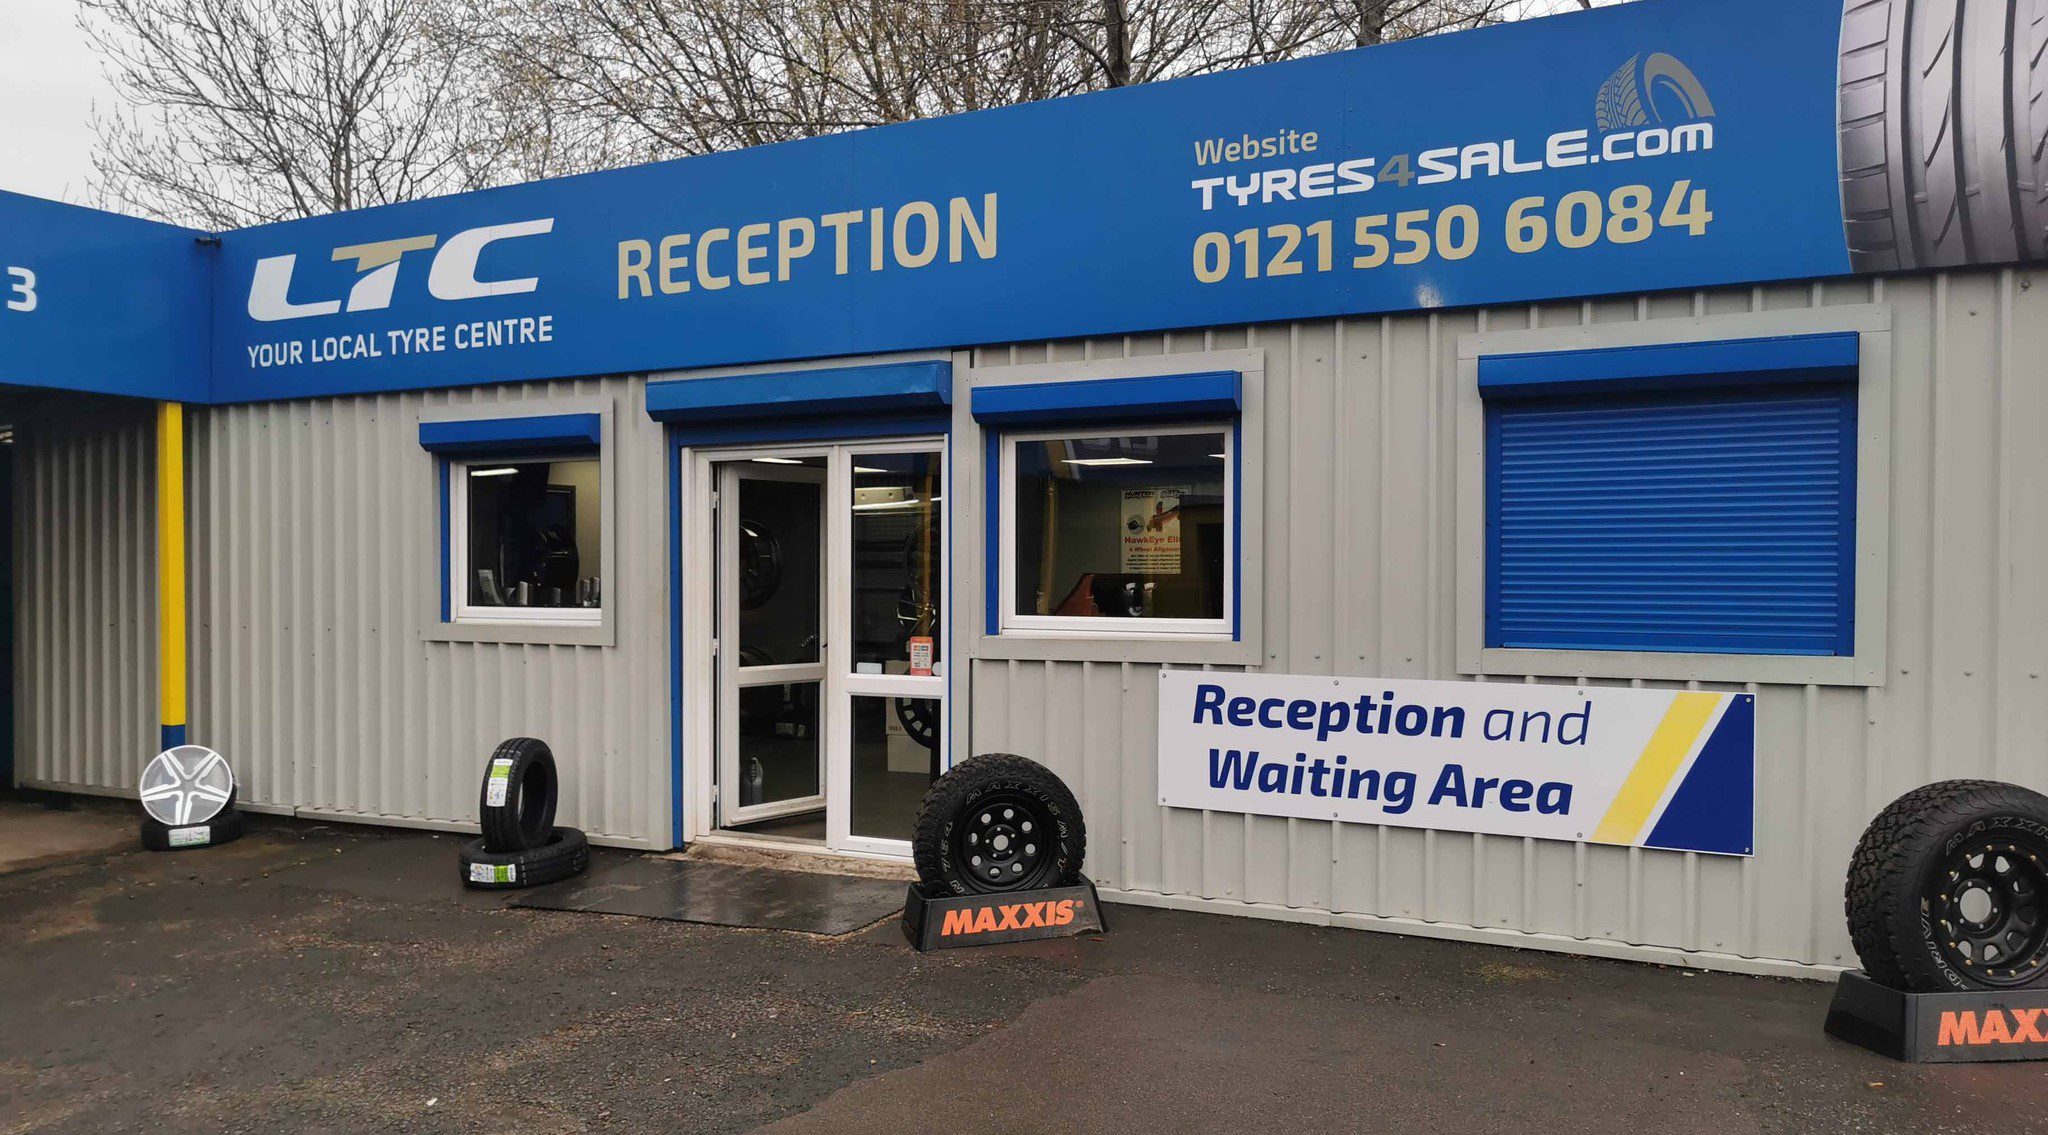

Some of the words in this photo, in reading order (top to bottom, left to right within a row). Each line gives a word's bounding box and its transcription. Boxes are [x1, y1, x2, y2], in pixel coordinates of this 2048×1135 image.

[1191, 122, 1714, 211] TYRES4SALE.com
[1195, 128, 1318, 167] Website
[617, 192, 998, 300] RECEPTION
[1192, 219, 1333, 284] 0121
[1353, 204, 1480, 268] 550
[1505, 179, 1714, 253] 6084
[6, 265, 38, 312] 3
[247, 217, 555, 322] LTC
[247, 340, 303, 369] YOUR
[311, 333, 382, 363] LOCAL
[387, 325, 446, 355] TYRE
[455, 315, 554, 350] CENTRE
[1192, 683, 1466, 743] Reception
[1482, 700, 1593, 746] and
[1207, 747, 1418, 816] Waiting
[1427, 763, 1574, 816] Area
[1937, 1007, 2048, 1046] MAX
